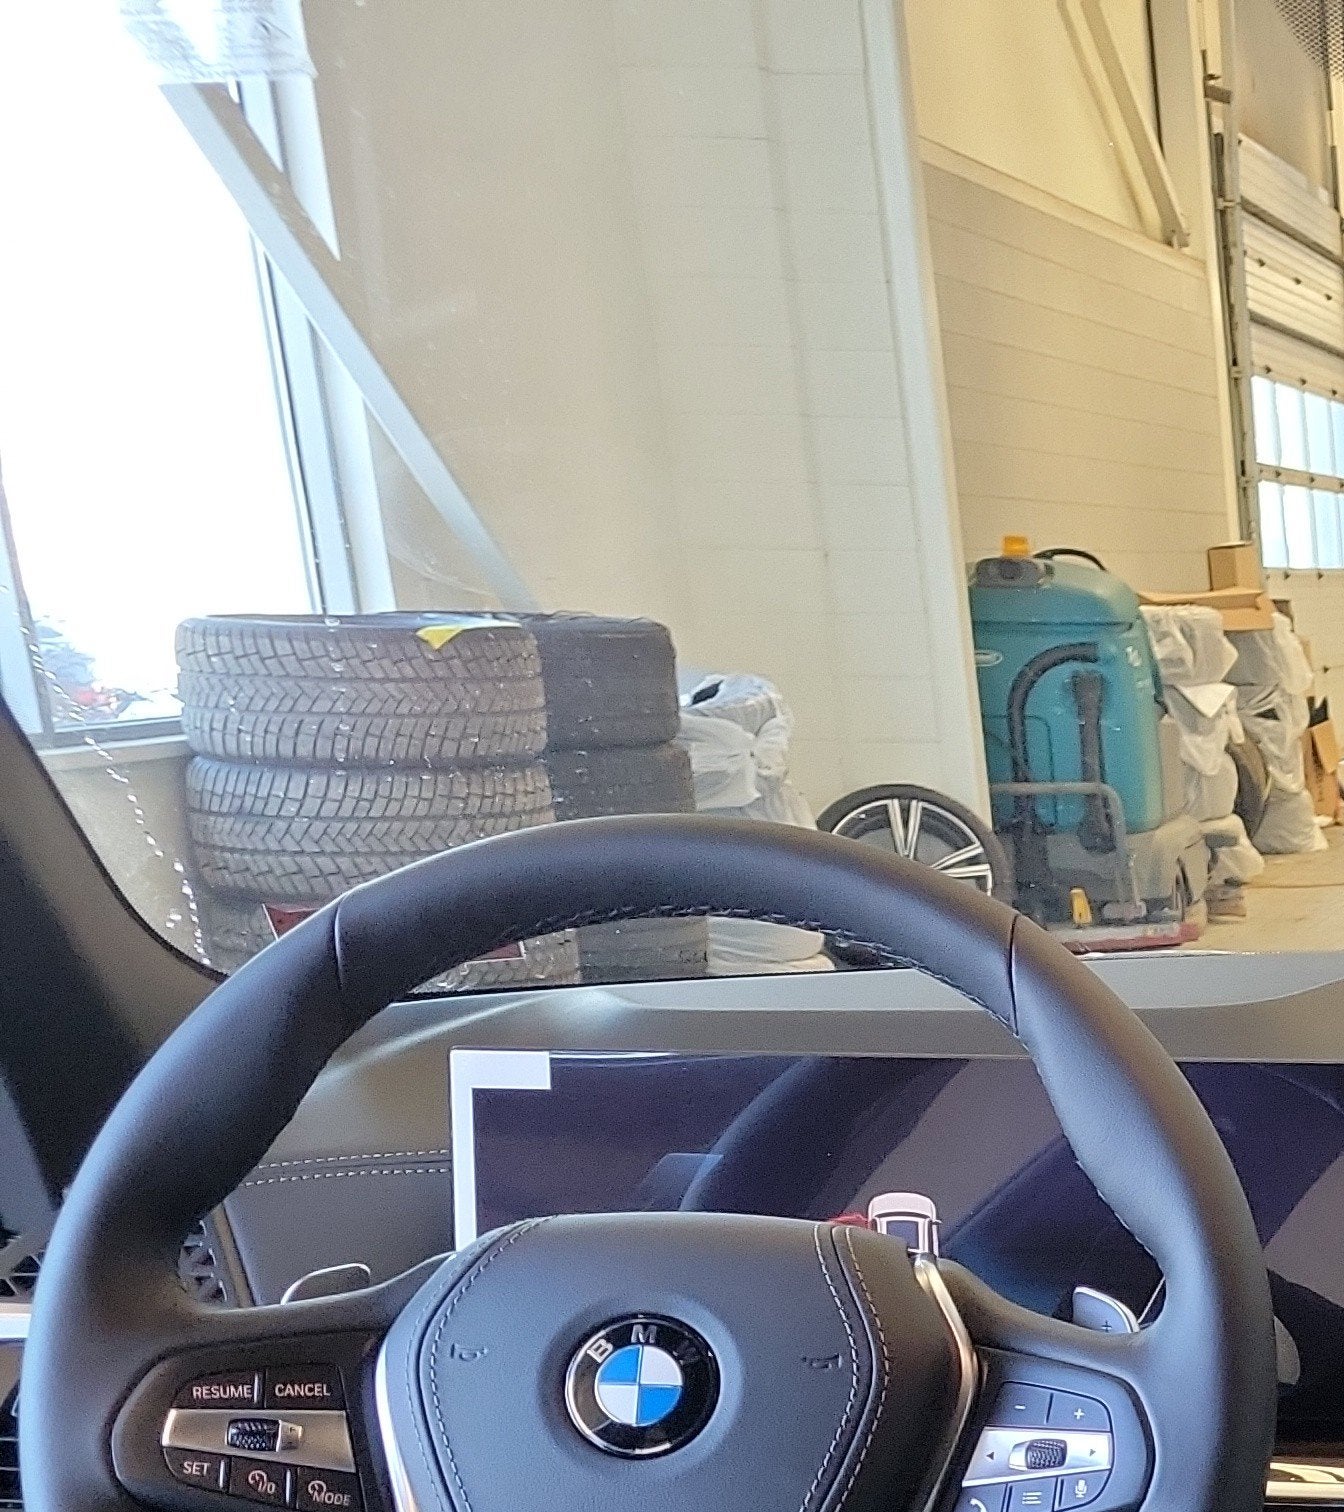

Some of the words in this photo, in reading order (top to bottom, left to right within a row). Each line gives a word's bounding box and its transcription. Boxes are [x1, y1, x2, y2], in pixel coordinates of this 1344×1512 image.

[192, 1385, 252, 1399] RESUME
[275, 1383, 331, 1397] CANCEL
[183, 1461, 212, 1476] SET
[312, 1492, 351, 1507] MODE
